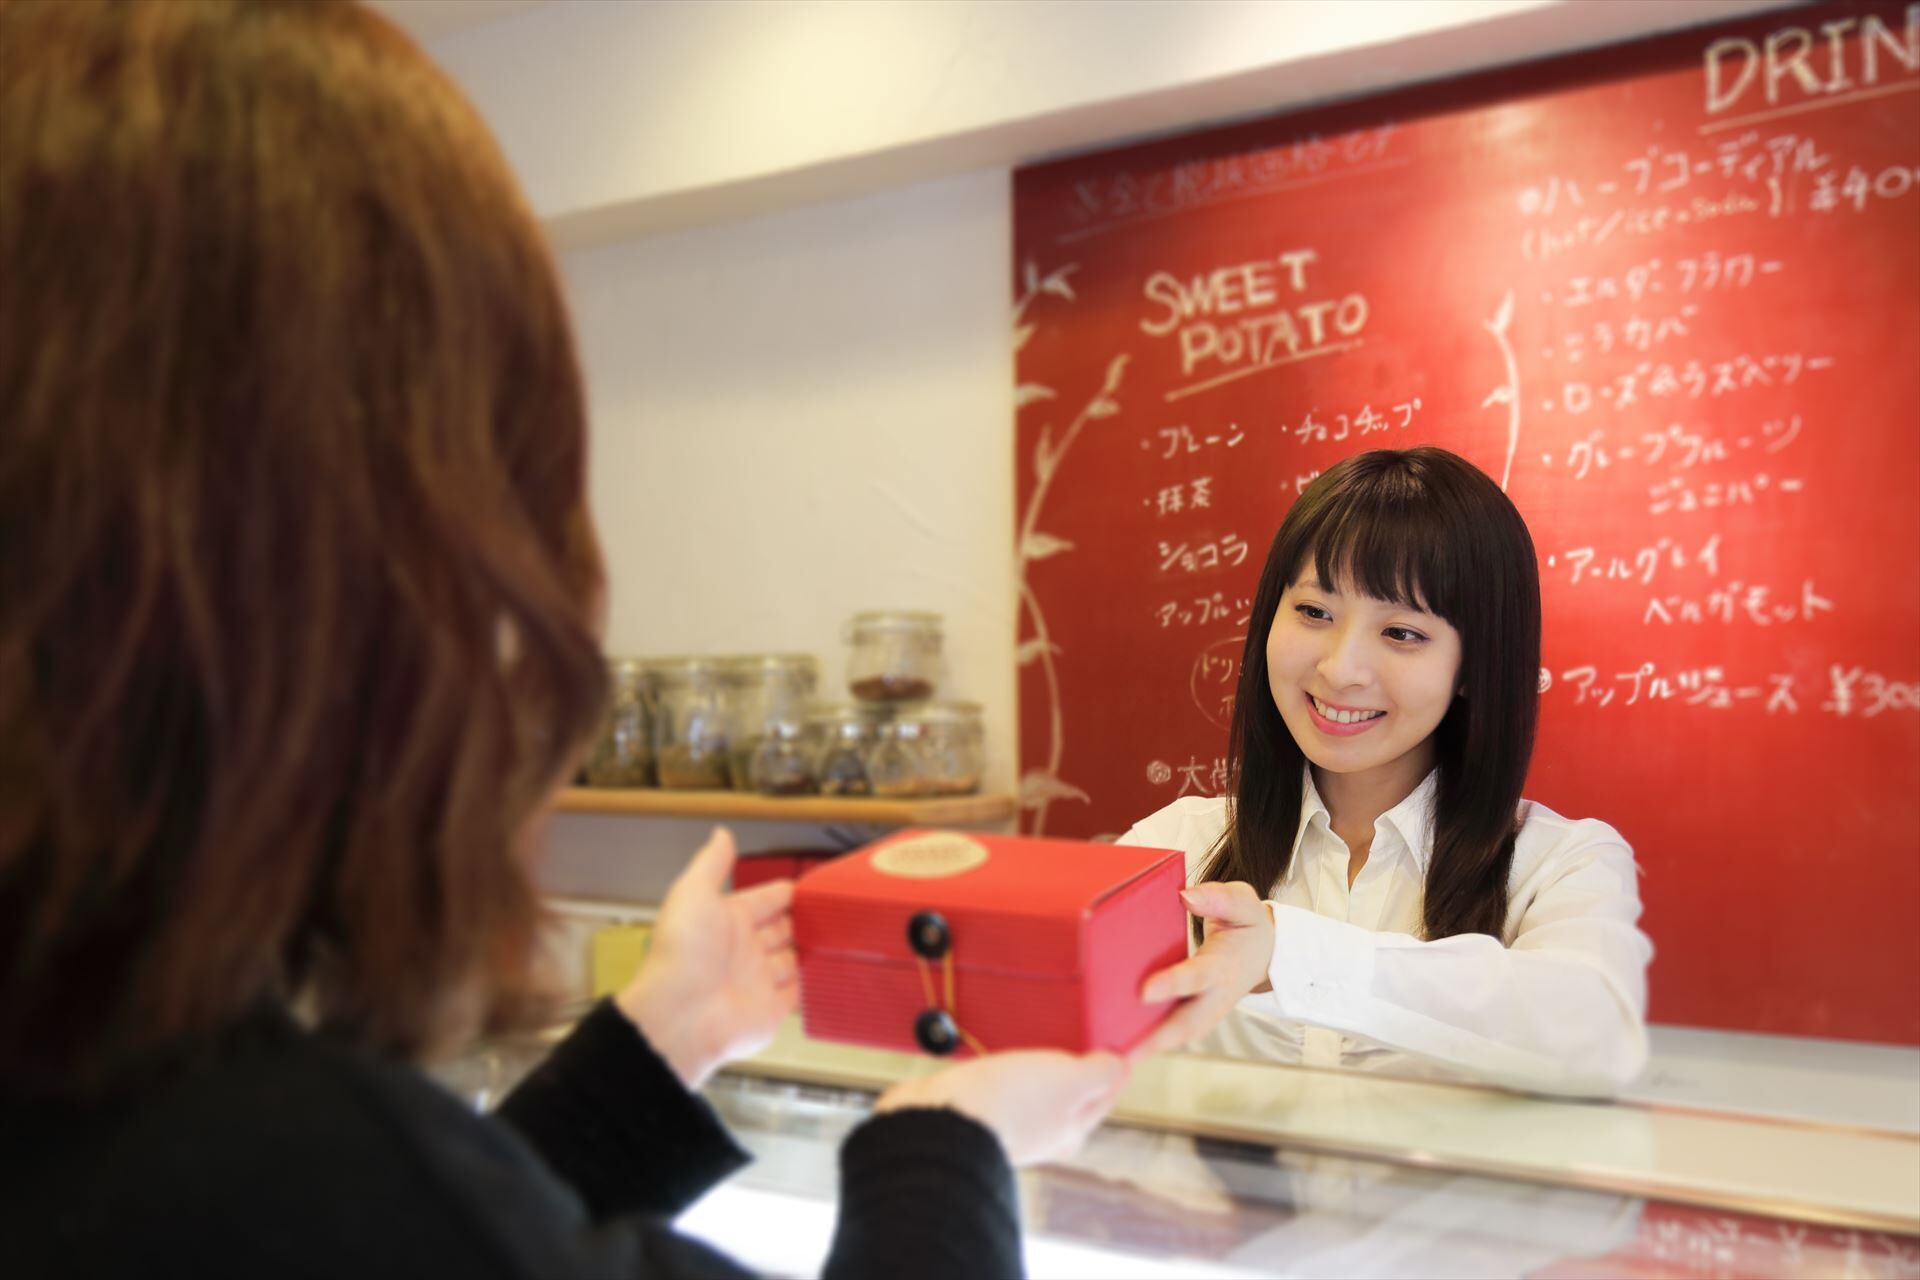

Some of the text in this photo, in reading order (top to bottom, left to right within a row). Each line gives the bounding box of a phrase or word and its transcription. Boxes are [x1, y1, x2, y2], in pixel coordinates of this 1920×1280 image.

[1808, 164, 1920, 212] ¥40
[1139, 249, 1317, 336] SWEET
[1180, 293, 1368, 374] POTATO
[1157, 533, 1249, 572] ショコラ
[1564, 534, 1721, 584] アールグレイ
[1562, 662, 1798, 716] アップルジュース
